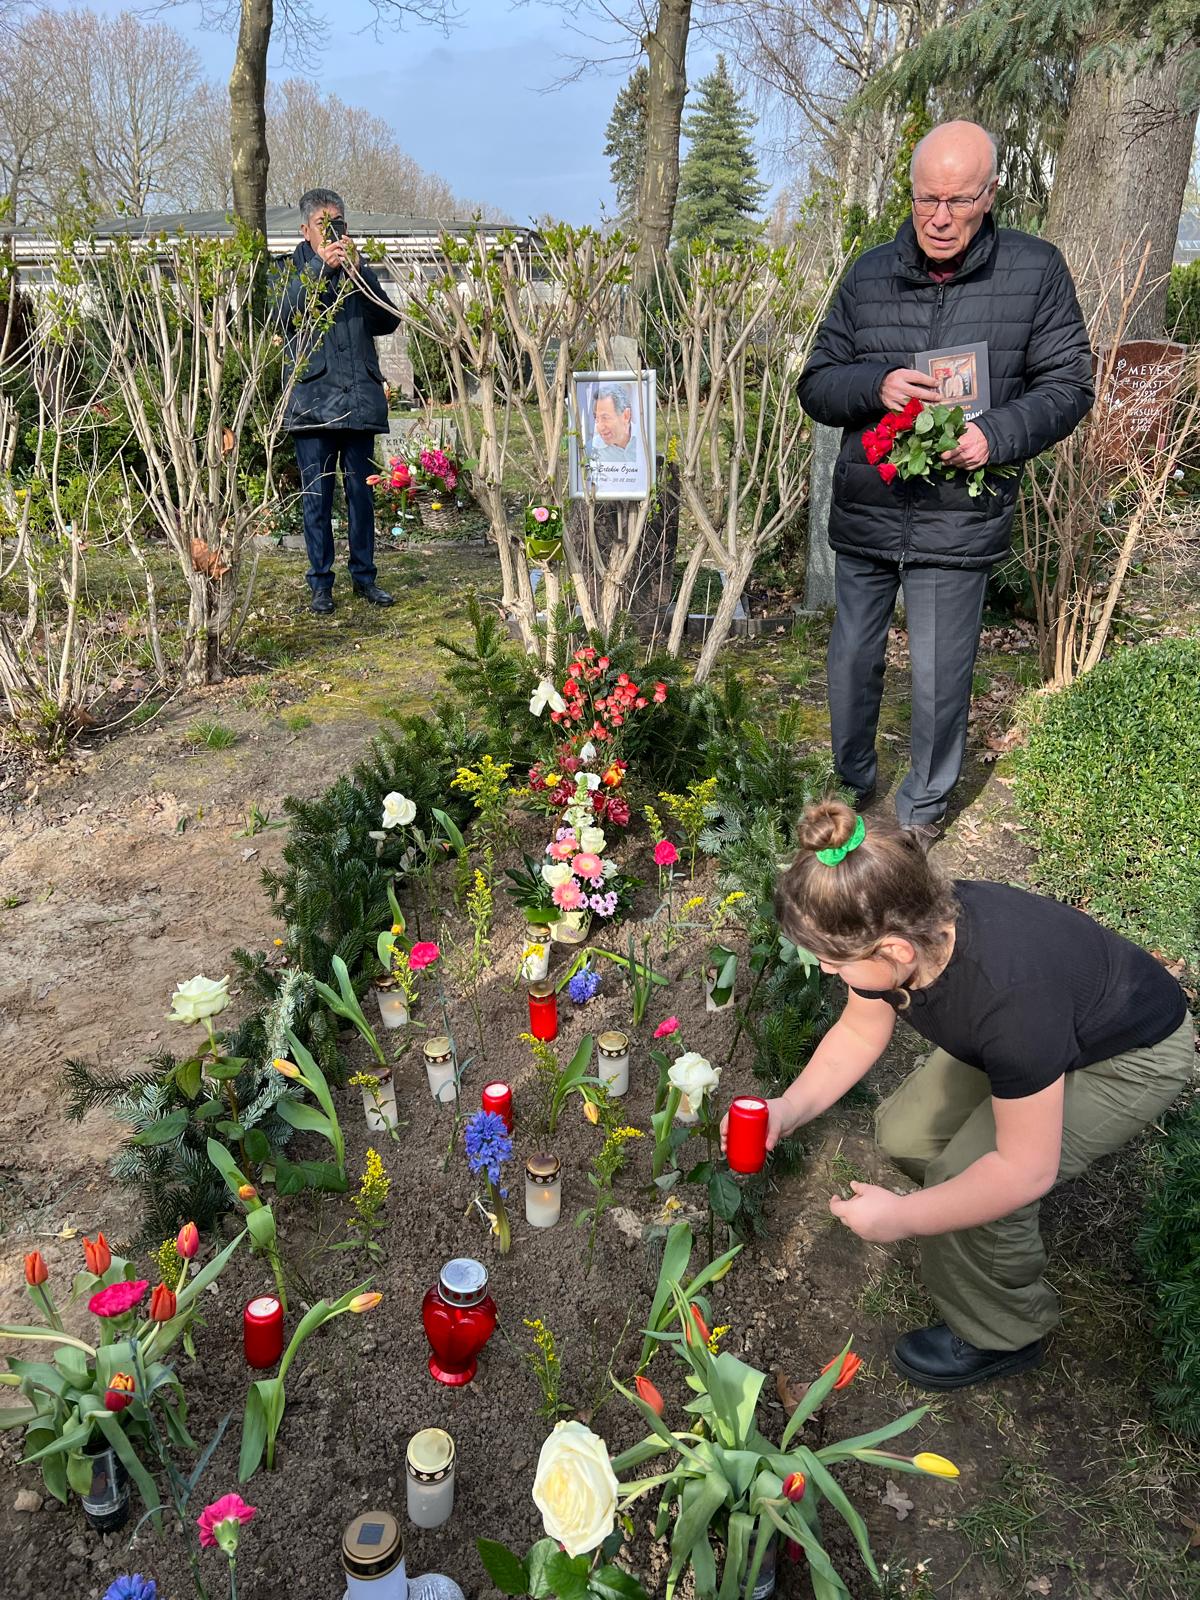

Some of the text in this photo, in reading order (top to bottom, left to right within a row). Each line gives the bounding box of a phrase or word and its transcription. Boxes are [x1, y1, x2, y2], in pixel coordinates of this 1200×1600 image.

[1128, 365, 1171, 375] MEYER
[1132, 380, 1162, 389] HORST
[598, 464, 619, 473] Ertekin
[621, 463, 639, 474] Özcan
